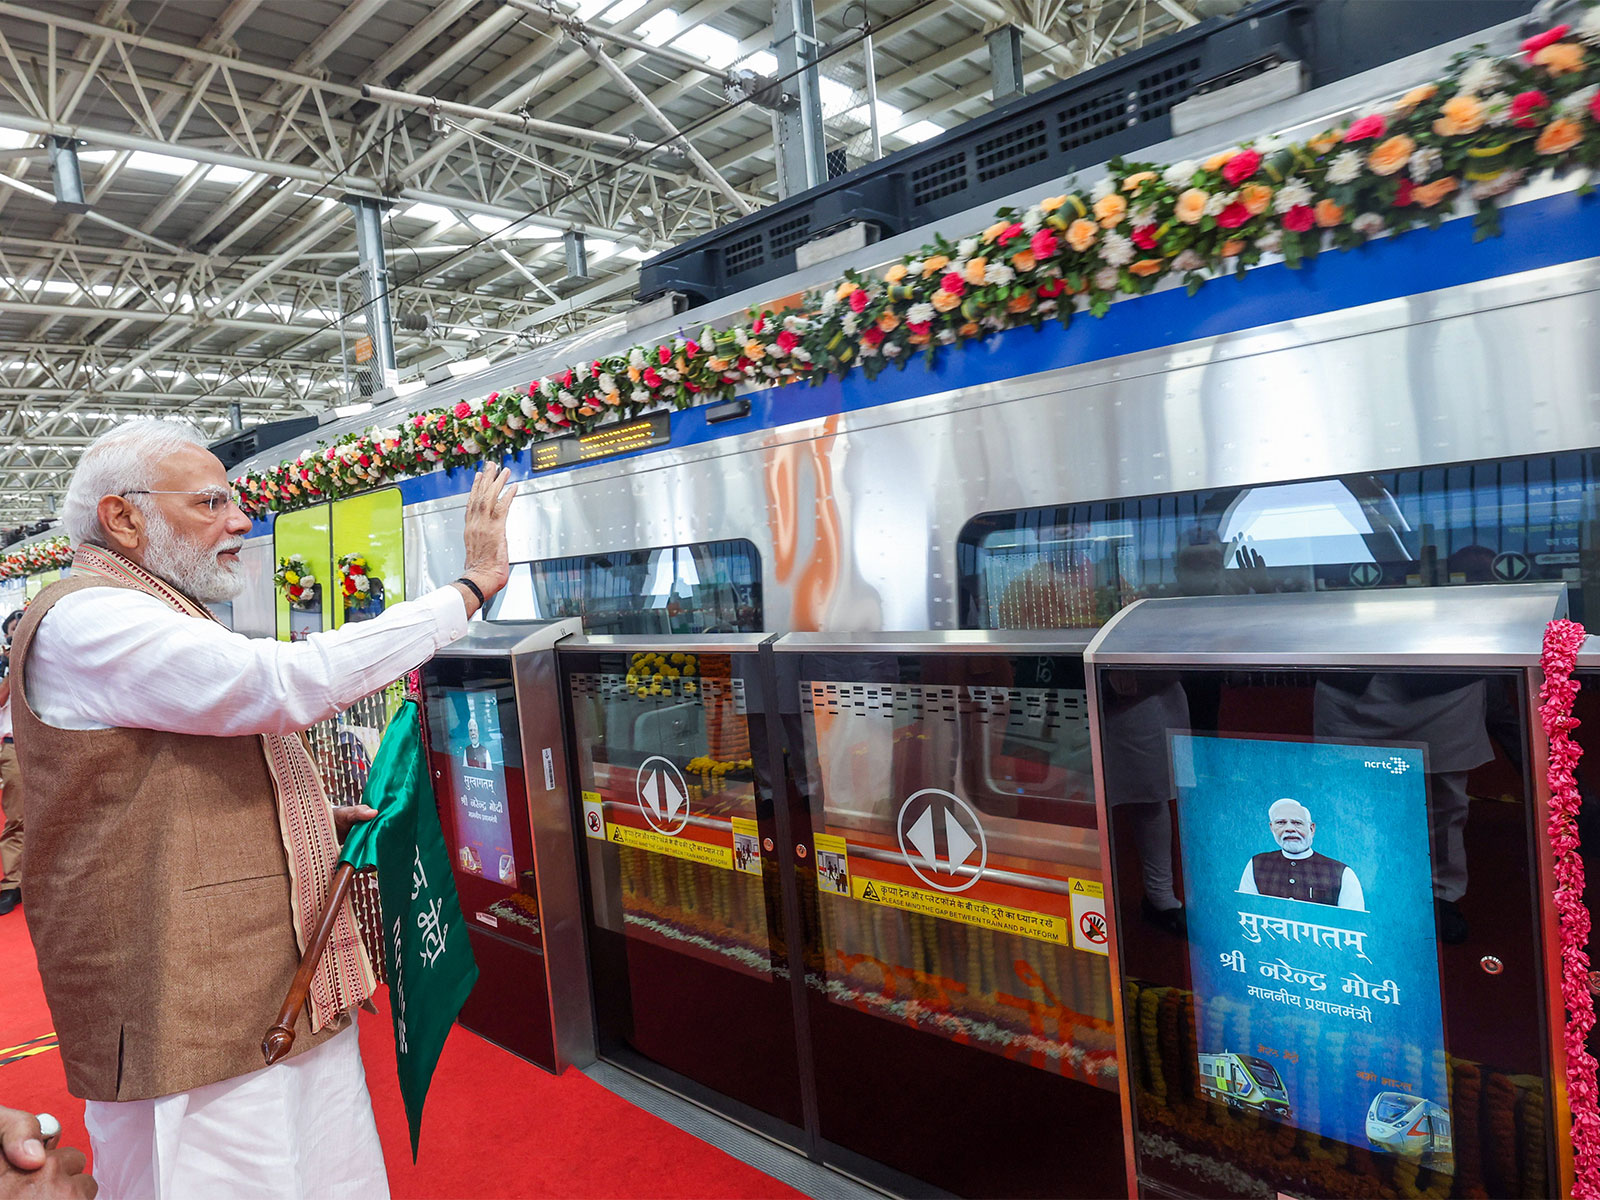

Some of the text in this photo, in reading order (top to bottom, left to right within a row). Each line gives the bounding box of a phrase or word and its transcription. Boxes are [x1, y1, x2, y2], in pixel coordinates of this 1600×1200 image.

[1364, 760, 1392, 770] ncrtc
[882, 897, 1059, 940] PLEASE MIND THE GAP BETWEEN TRAIN AND PLATFORM
[1237, 911, 1373, 965] सुस्वागतम्
[1219, 949, 1401, 1006] श्री नरेन्द्र मोदी
[1247, 985, 1373, 1024] माननीय प्रधानमंत्री
